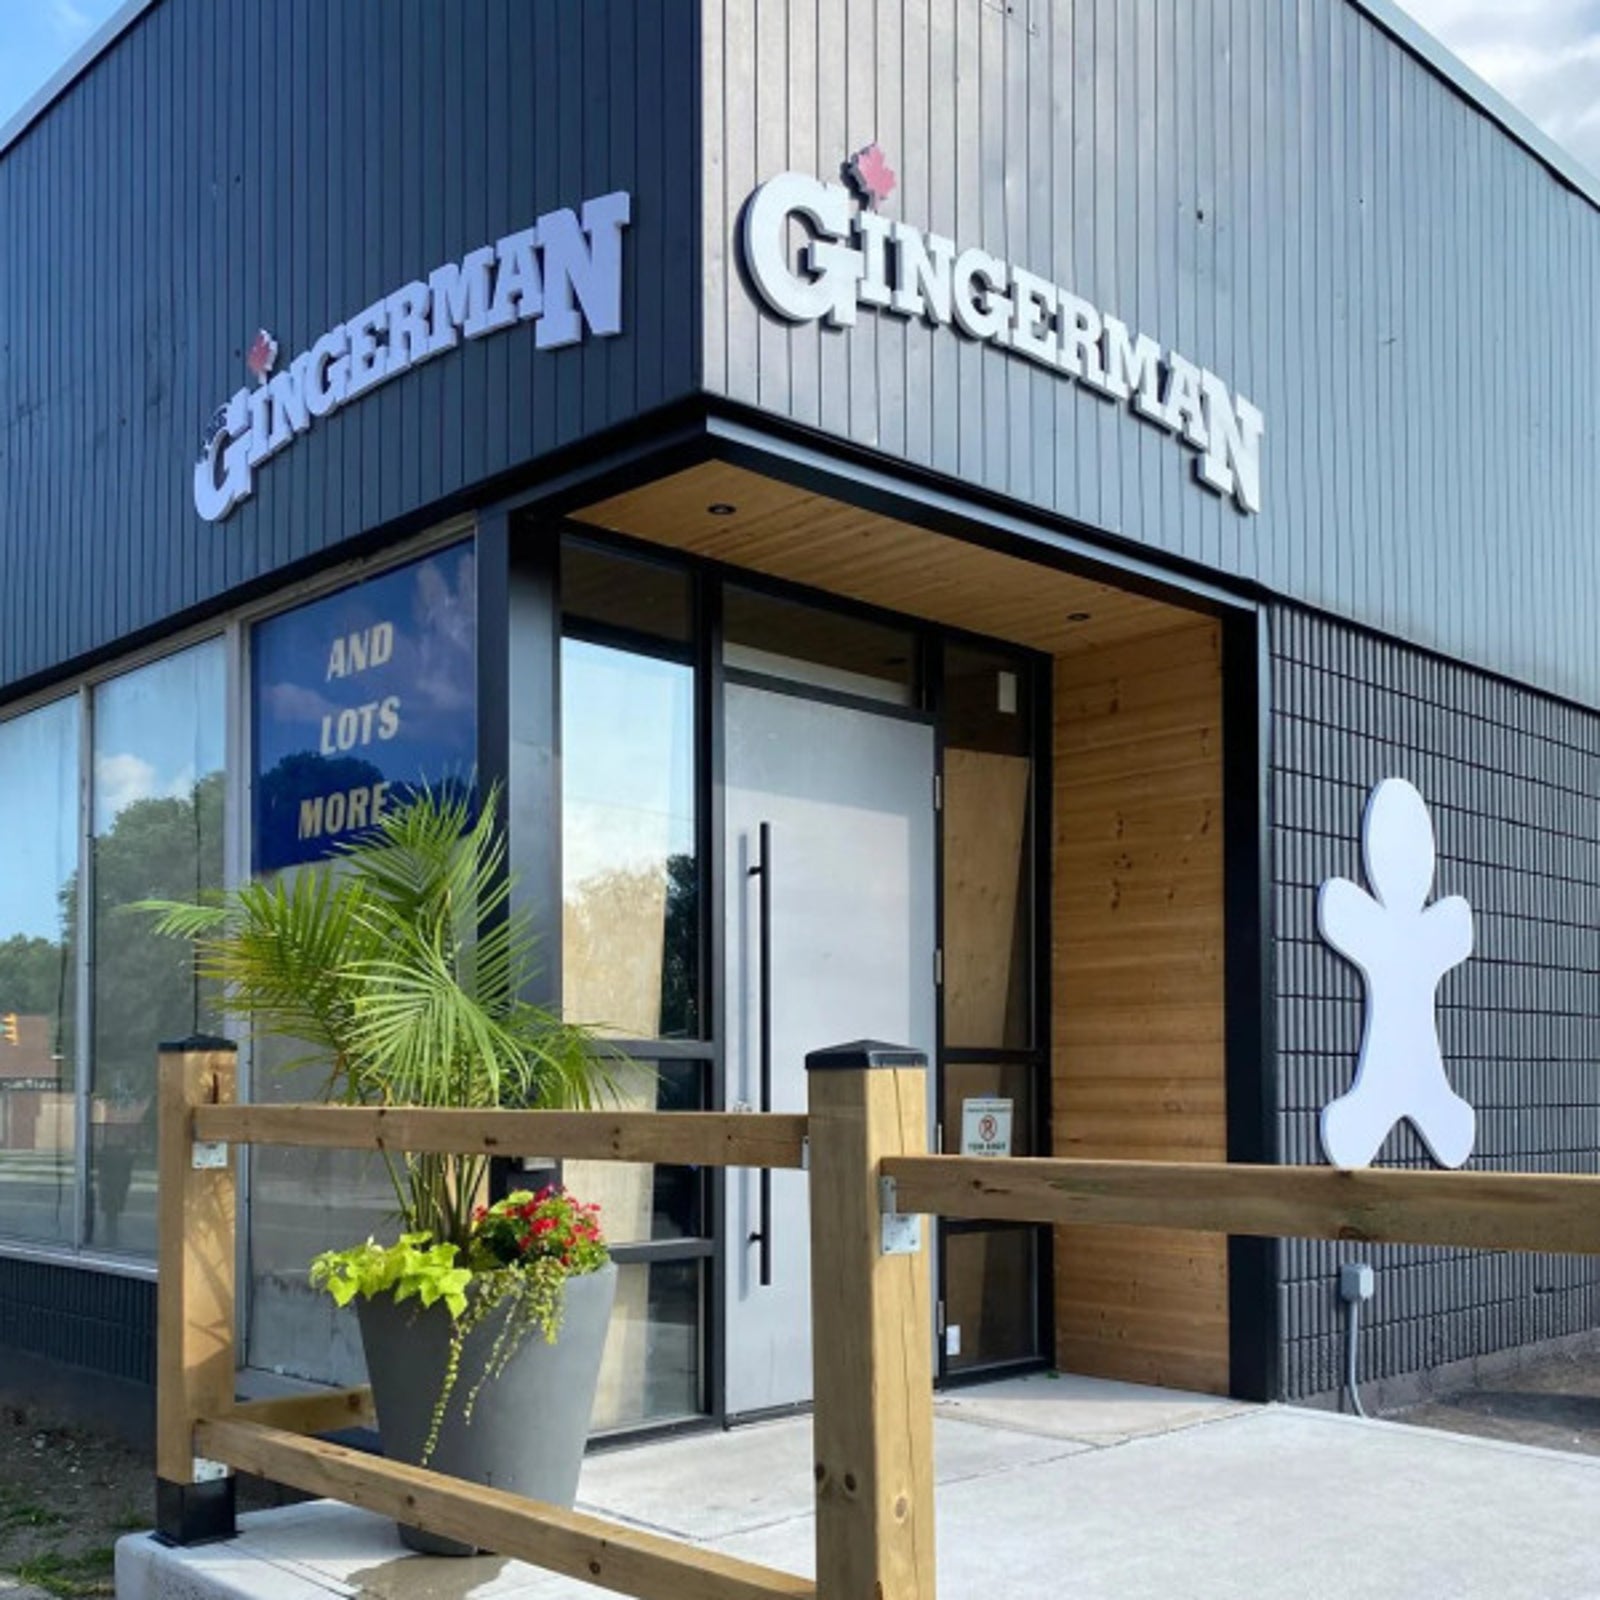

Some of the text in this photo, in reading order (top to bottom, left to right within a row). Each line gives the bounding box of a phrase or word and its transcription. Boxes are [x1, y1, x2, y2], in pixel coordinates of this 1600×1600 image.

[194, 191, 630, 521] GINGERMAN
[741, 171, 1264, 514] GINGERMAN
[326, 621, 394, 682] AND
[319, 696, 400, 756] LOTS
[298, 781, 390, 841] MORE
